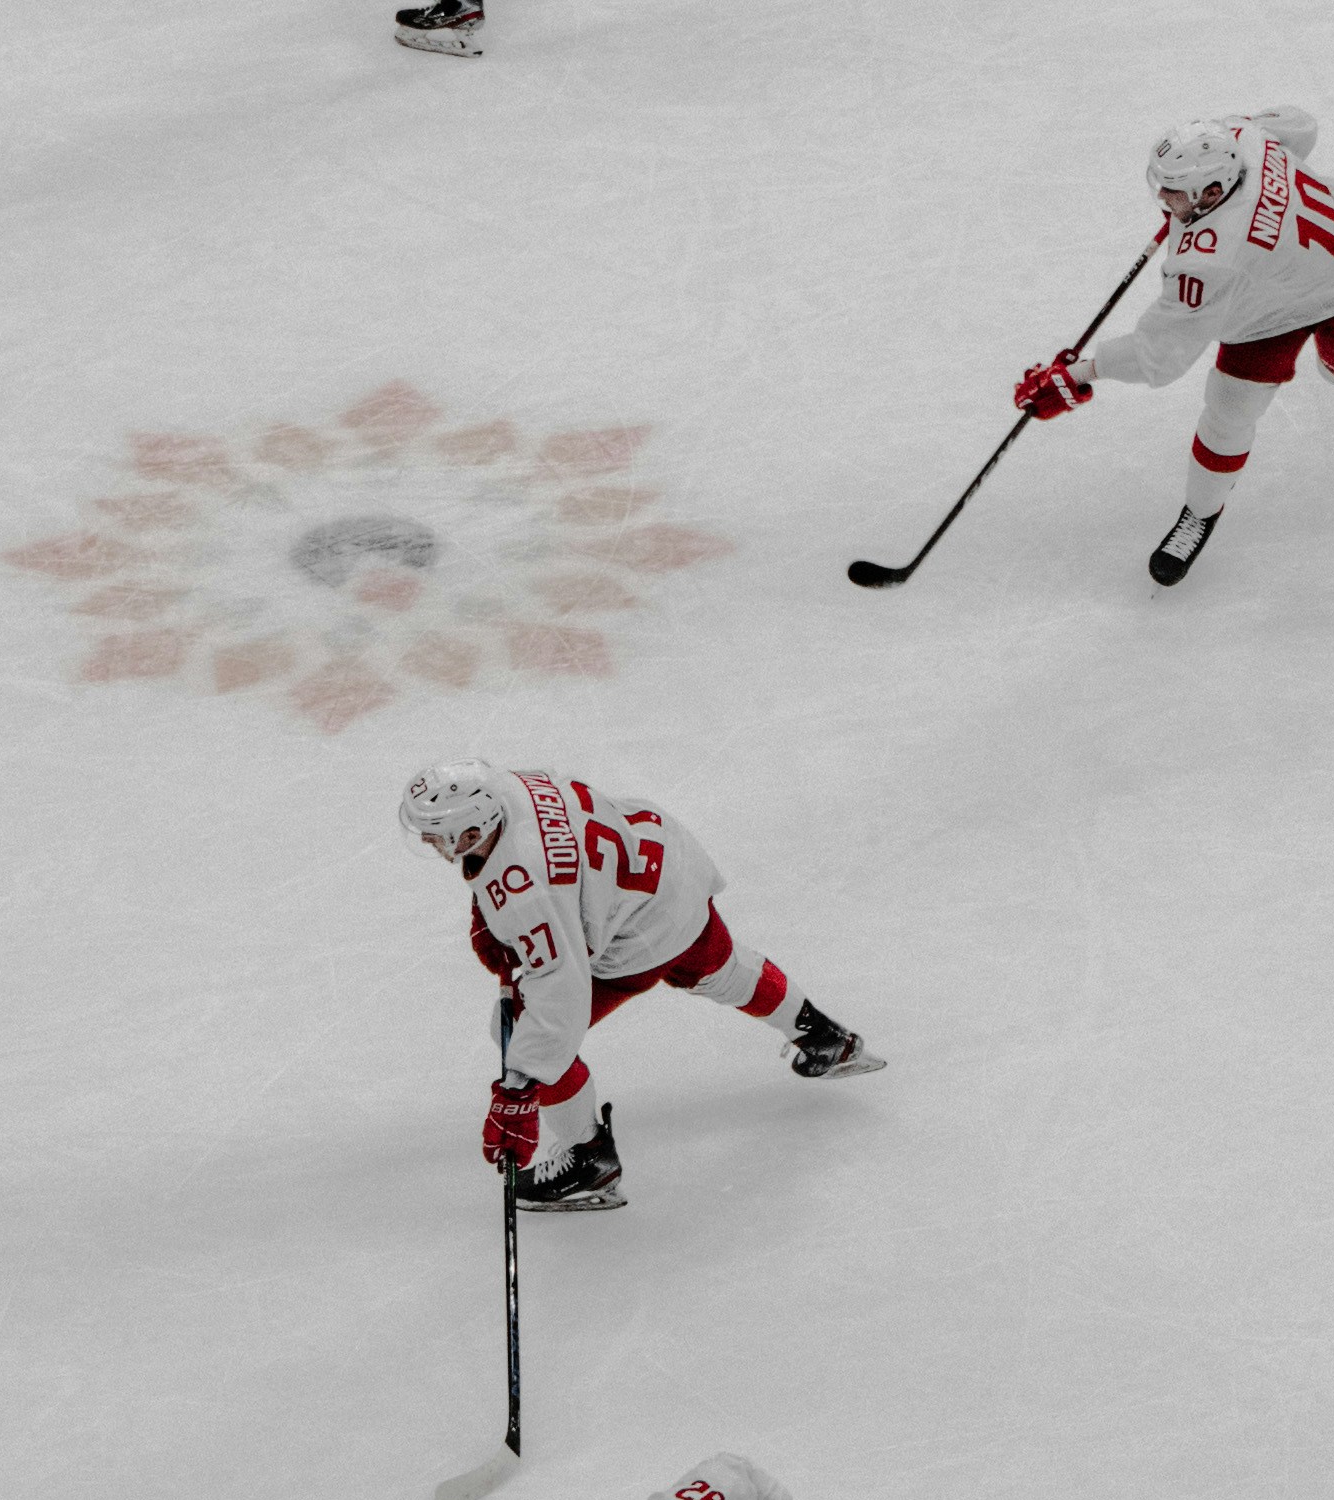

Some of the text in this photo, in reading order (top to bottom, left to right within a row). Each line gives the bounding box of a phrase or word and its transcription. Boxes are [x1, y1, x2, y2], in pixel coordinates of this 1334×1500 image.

[1177, 273, 1204, 309] 10
[514, 771, 578, 879] TORCHENYU
[517, 921, 558, 969] 27
